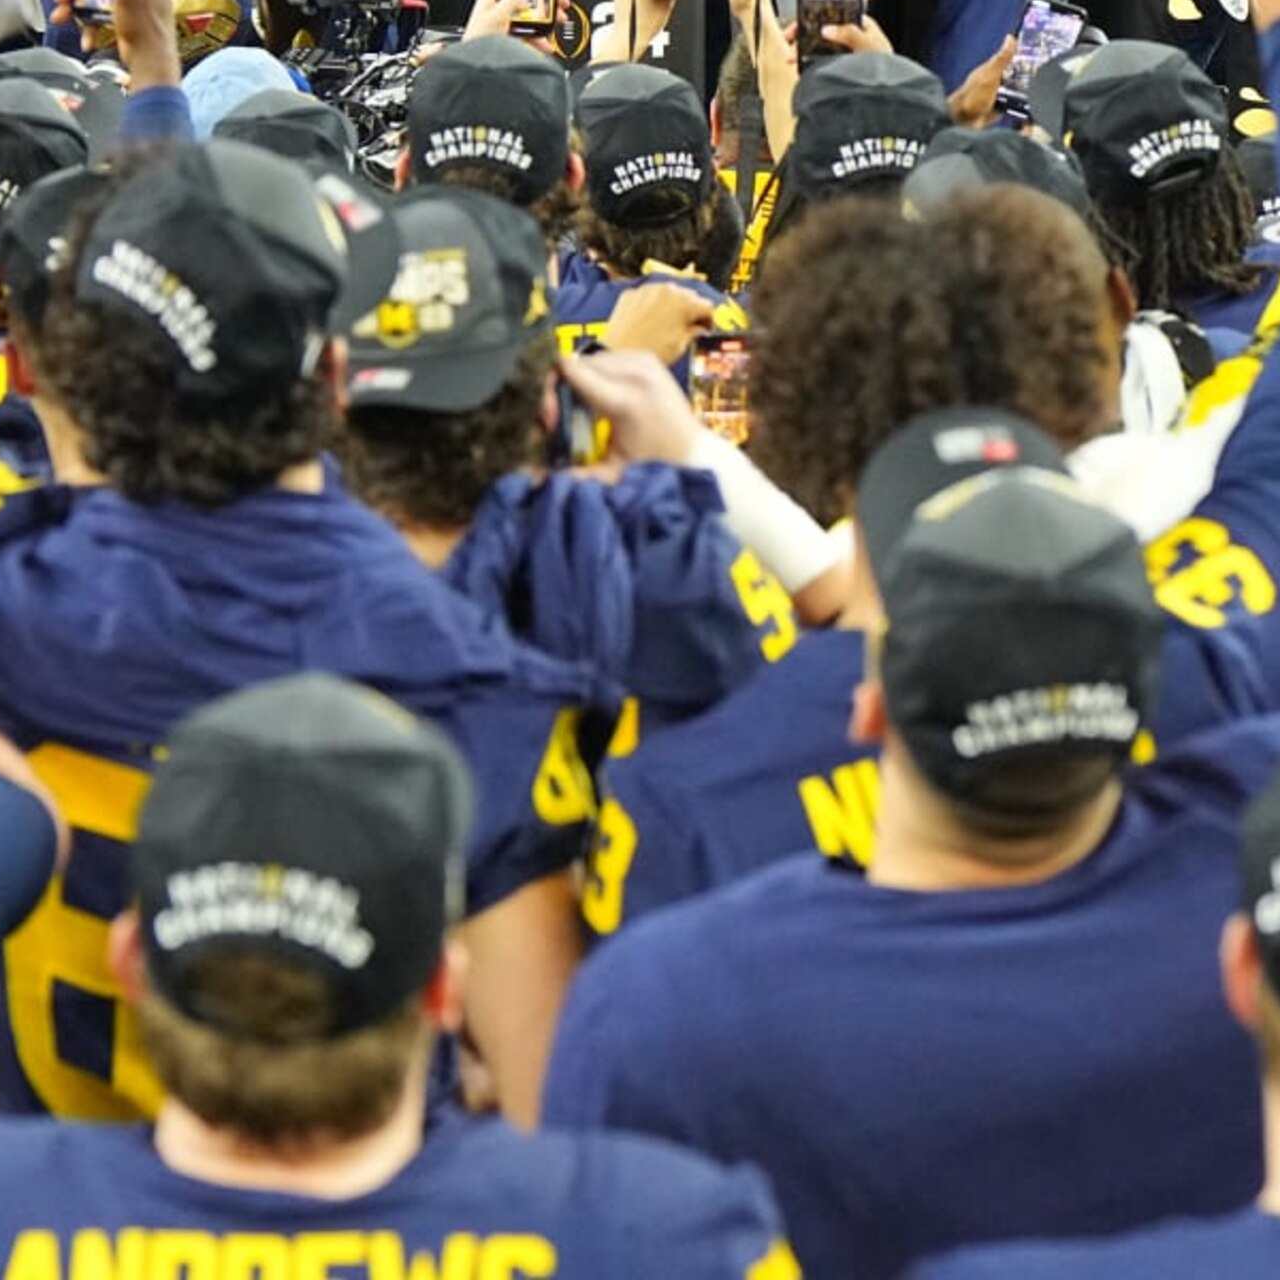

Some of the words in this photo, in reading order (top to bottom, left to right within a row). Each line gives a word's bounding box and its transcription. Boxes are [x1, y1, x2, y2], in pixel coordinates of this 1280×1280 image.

[429, 125, 524, 151] NATIONAL
[1127, 119, 1213, 161] NATIONAL
[424, 142, 533, 170] CHAMPIONS
[613, 152, 695, 178] NATIONAL
[609, 166, 702, 196] CHAMPIONS
